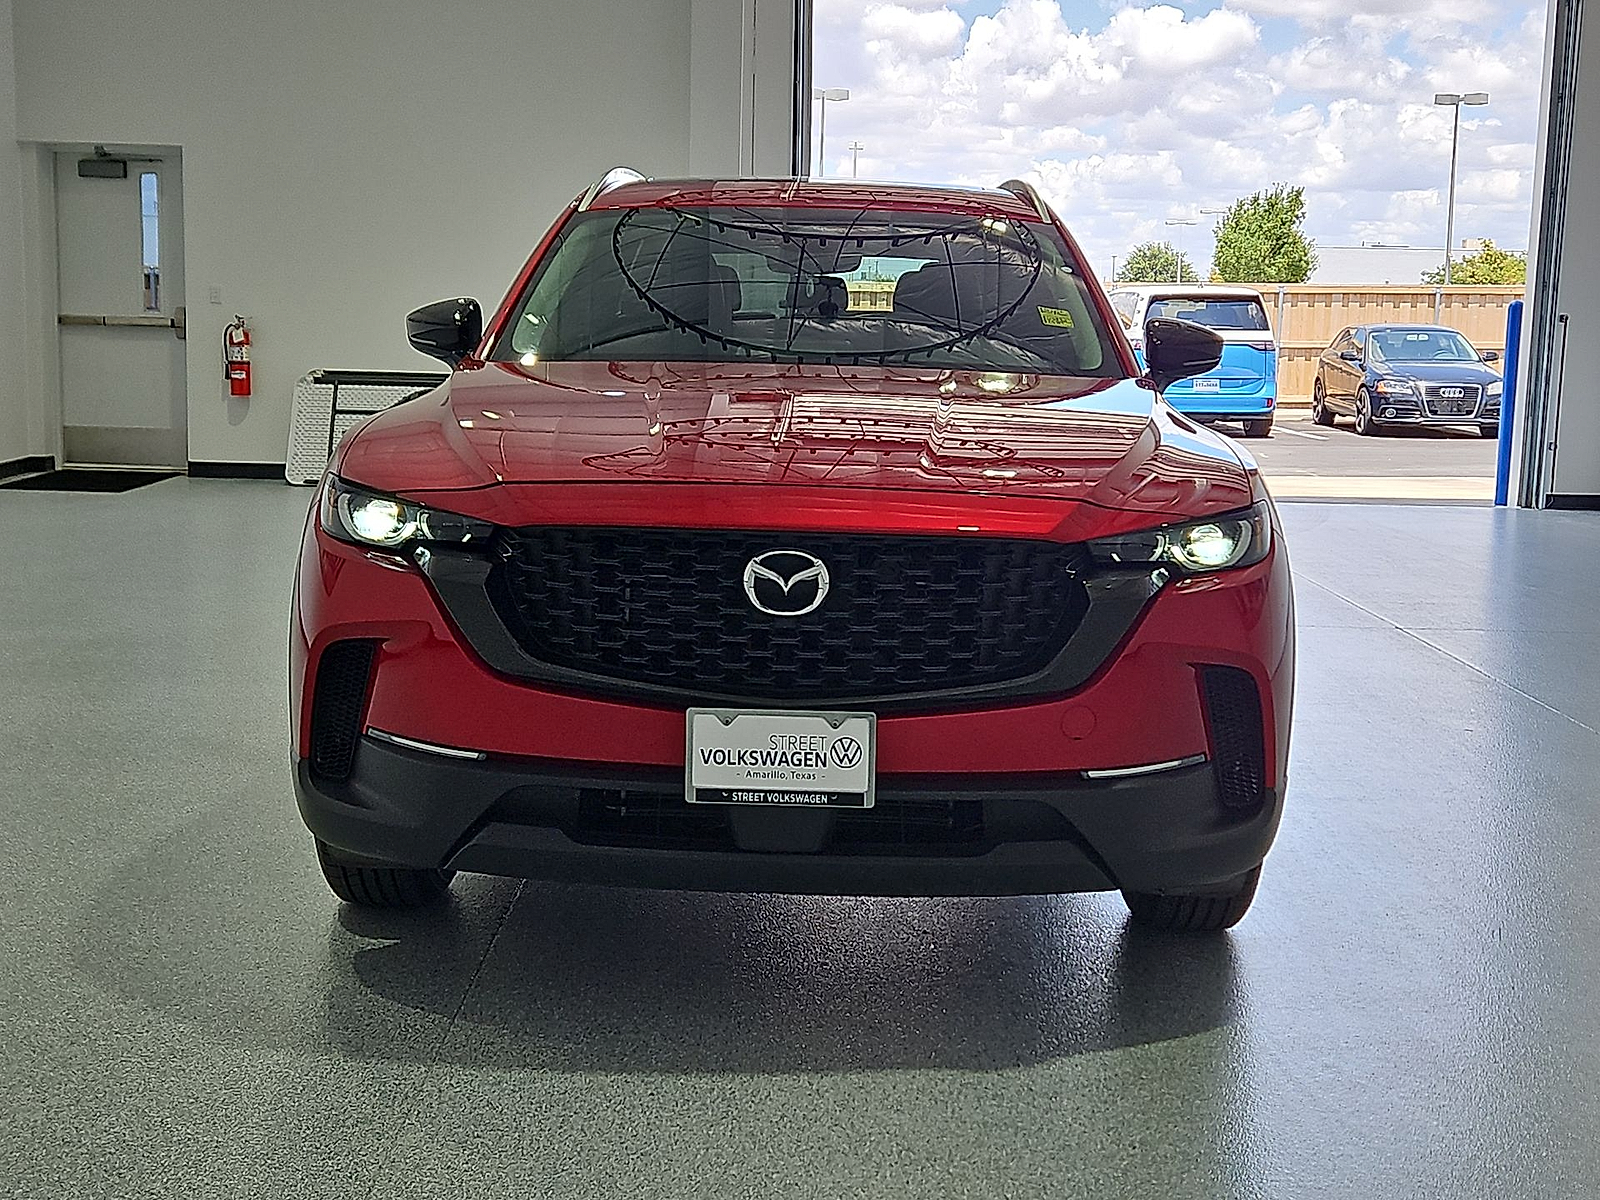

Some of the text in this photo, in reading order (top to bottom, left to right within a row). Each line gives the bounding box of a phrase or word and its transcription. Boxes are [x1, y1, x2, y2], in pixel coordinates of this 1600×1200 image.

[768, 734, 828, 752] STREET
[700, 748, 828, 768] VOLKSWAGEN
[745, 769, 817, 780] Amarillo, Texas
[732, 791, 828, 804] STREET VOLKSWAGEN
